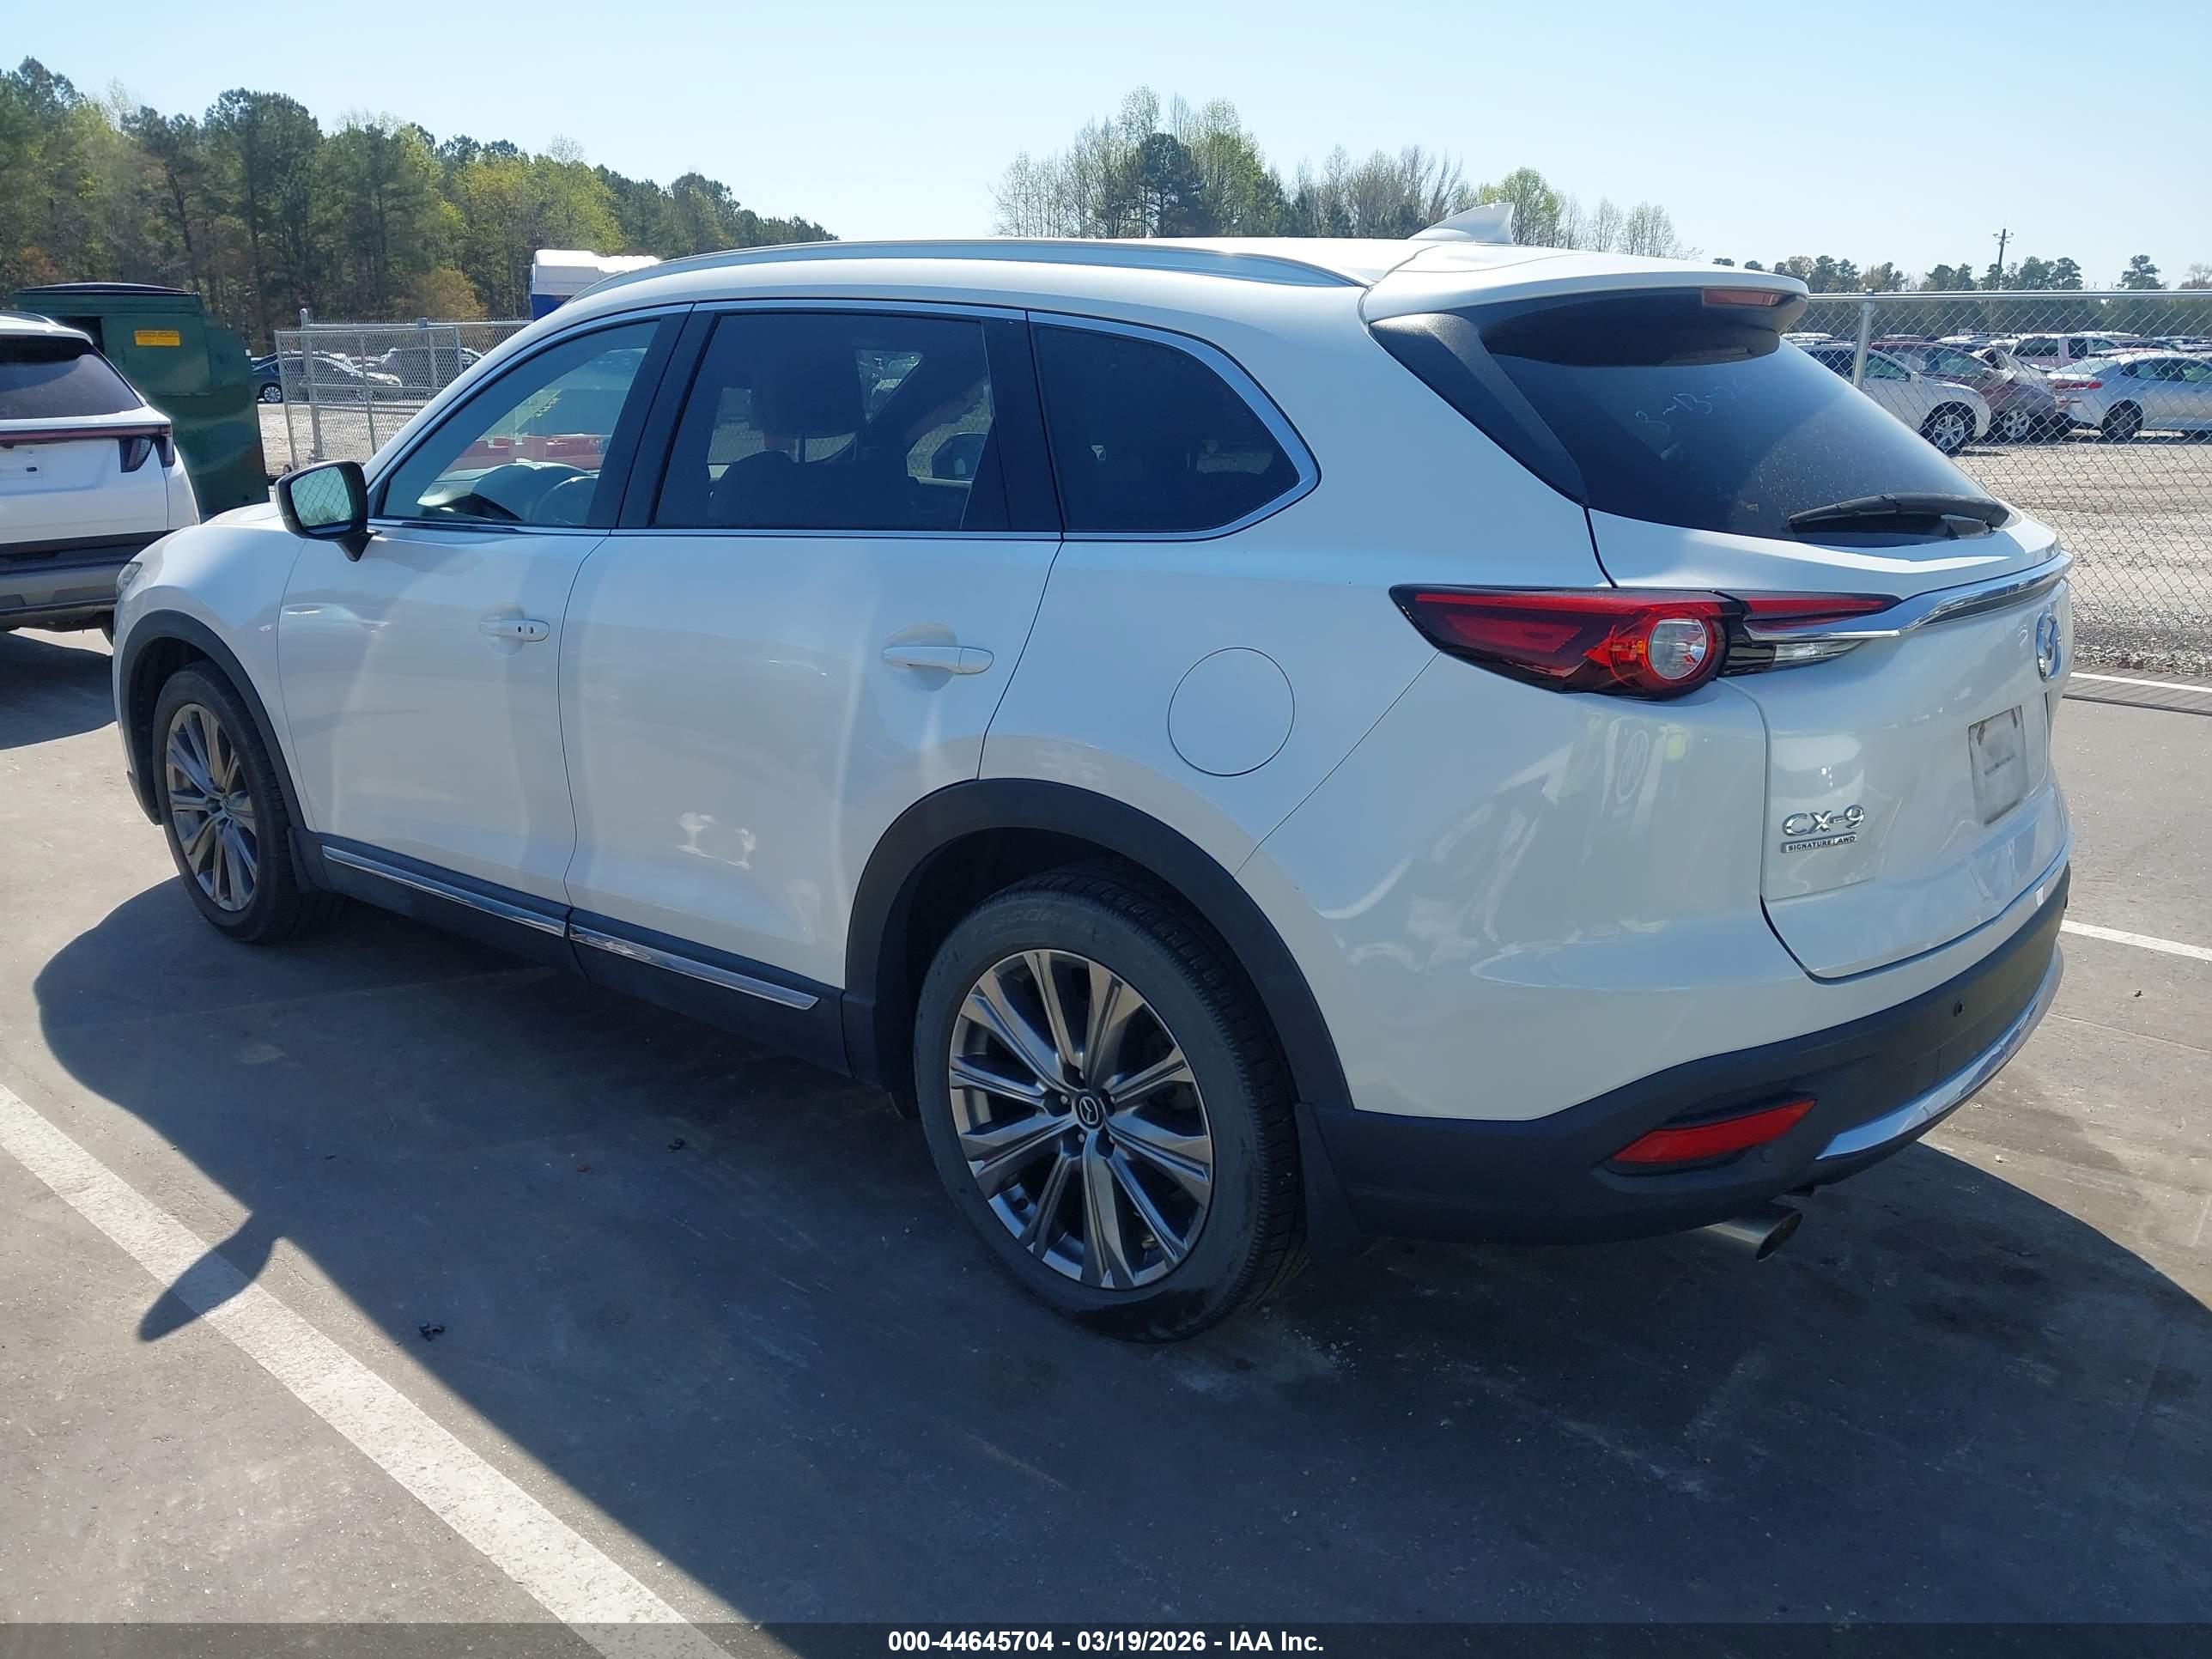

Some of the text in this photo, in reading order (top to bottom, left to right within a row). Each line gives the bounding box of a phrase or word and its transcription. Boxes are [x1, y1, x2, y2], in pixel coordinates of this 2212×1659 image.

[1782, 804, 1865, 836] CX-9
[1787, 835, 1856, 852] SIGNATURE AWD
